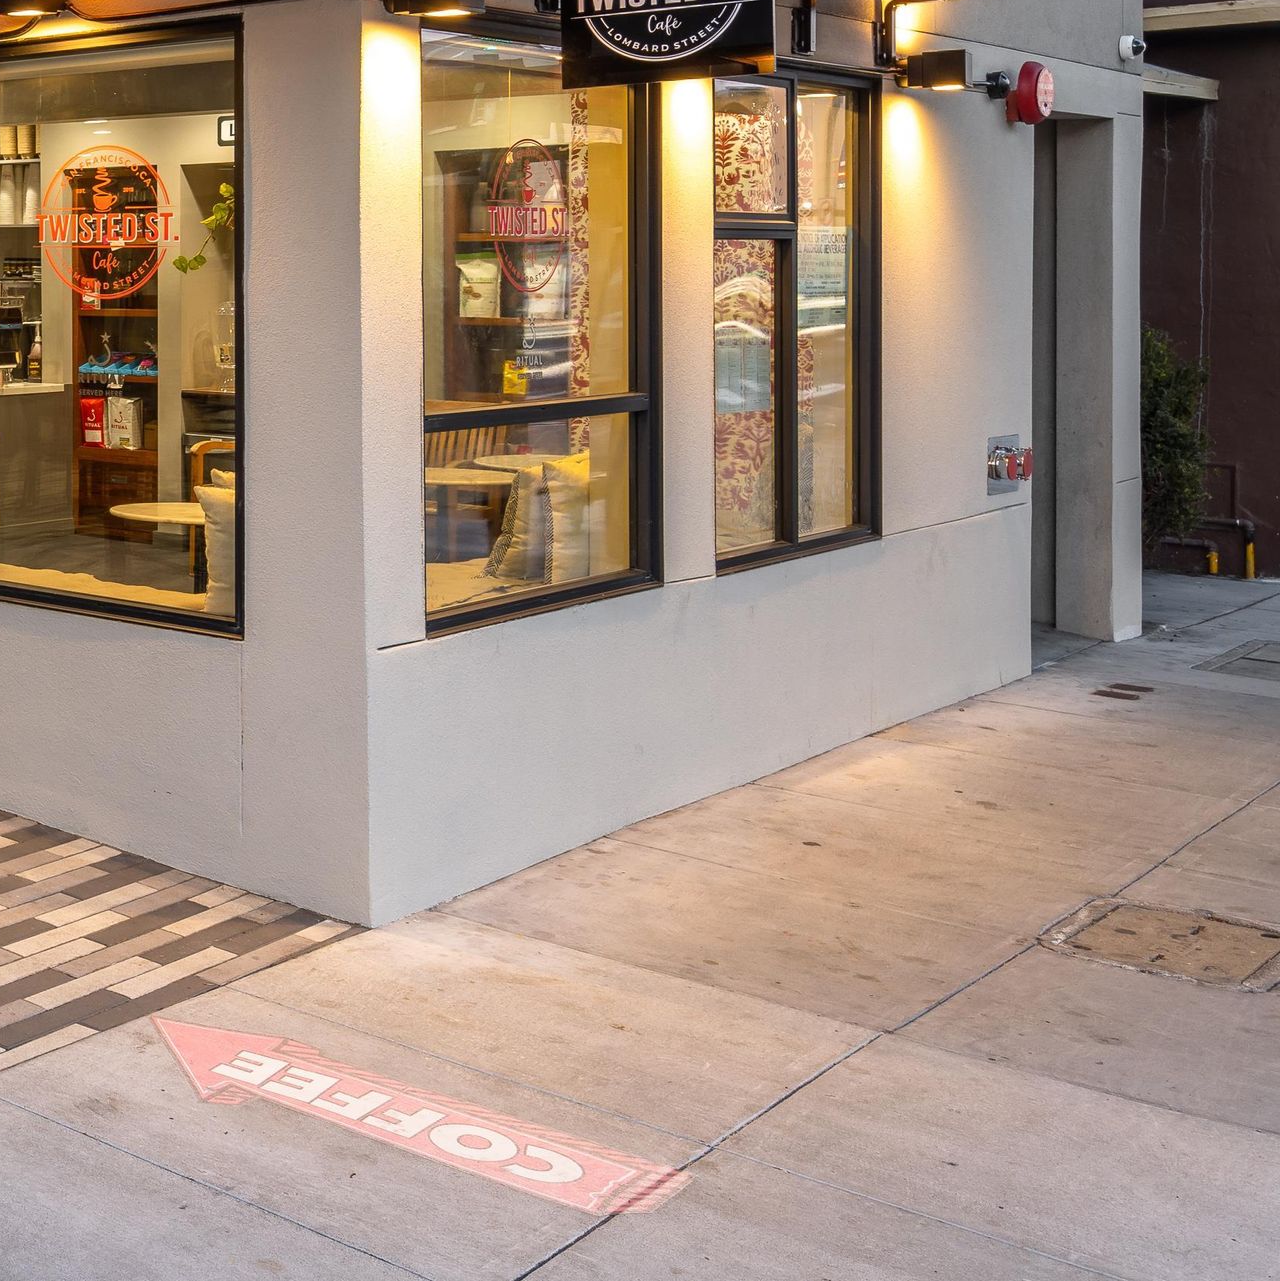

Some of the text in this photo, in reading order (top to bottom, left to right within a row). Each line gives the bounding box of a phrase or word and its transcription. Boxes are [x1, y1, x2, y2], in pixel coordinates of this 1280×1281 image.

[607, 18, 720, 53] LOMBARD STREET
[647, 14, 683, 36] Café
[35, 211, 181, 244] TWISTED ST.
[488, 206, 570, 237] TWISTED ST.
[92, 250, 120, 274] Café
[112, 259, 151, 290] STREET
[516, 354, 543, 367] RITUAL
[78, 389, 104, 397] SERVED
[210, 1049, 585, 1184] COFFEE
